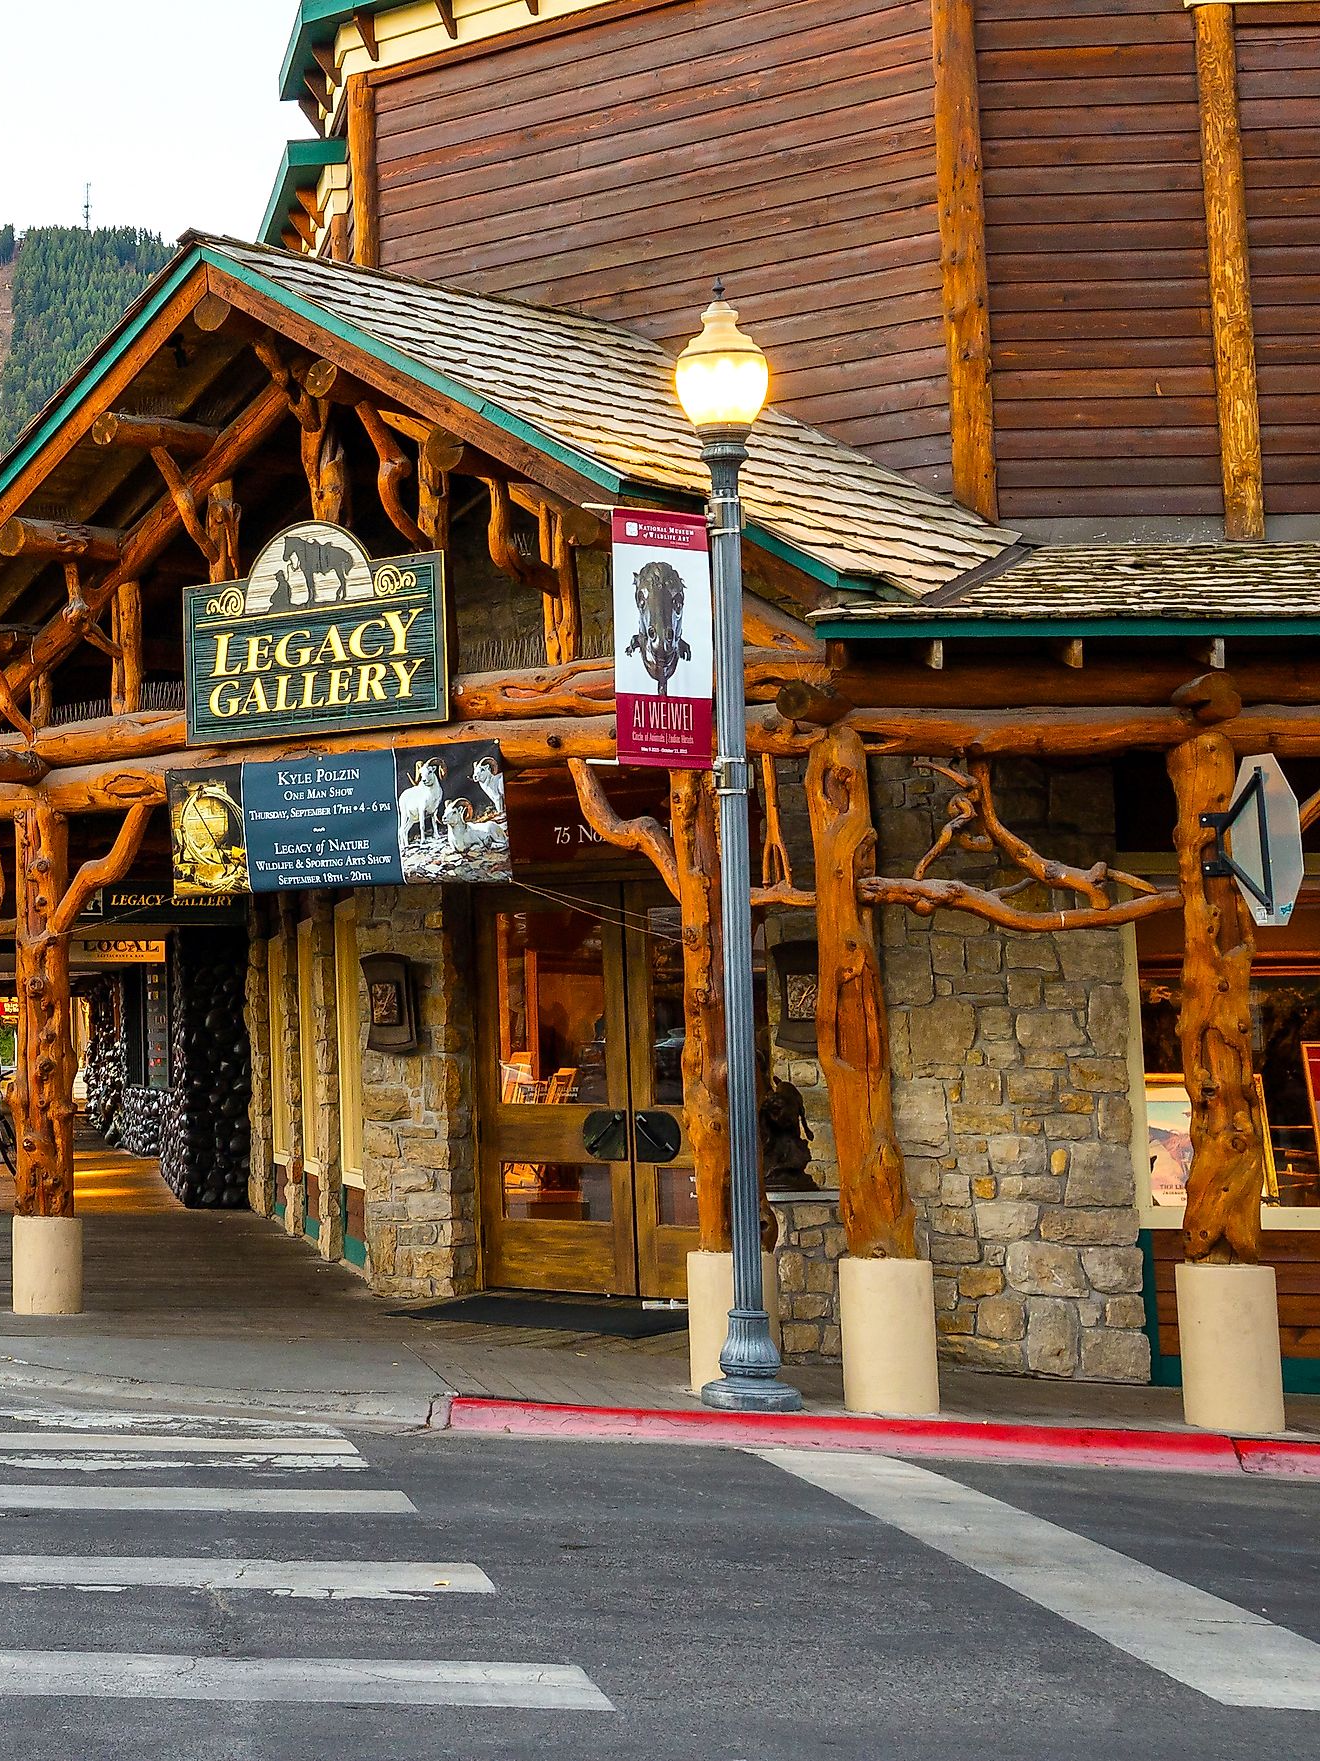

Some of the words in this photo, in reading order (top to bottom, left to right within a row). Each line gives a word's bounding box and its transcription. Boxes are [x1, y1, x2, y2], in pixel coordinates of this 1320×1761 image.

[638, 524, 667, 533] NATIONAL
[669, 527, 694, 536] MUSEUM
[649, 531, 676, 541] WILDLIFE
[209, 608, 425, 678] LEGACY
[208, 658, 426, 718] GALLERY
[633, 700, 645, 728] AI
[649, 701, 693, 731] WEIWEI
[278, 771, 312, 785] KYLE
[316, 768, 360, 782] POLZIN
[284, 791, 304, 801] ONE
[307, 788, 327, 799] MAN
[329, 787, 354, 796] SHOW
[554, 827, 571, 844] 75
[274, 842, 312, 854] LEGACY
[316, 840, 326, 855] of
[328, 839, 370, 851] NATURE
[256, 860, 294, 871] WILDLIFE
[295, 859, 304, 869] &
[305, 857, 344, 869] SPORTING
[345, 855, 366, 866] ARTS
[367, 854, 392, 864] SHOW
[111, 895, 165, 906] LEGACY
[171, 895, 235, 906] GALLERY
